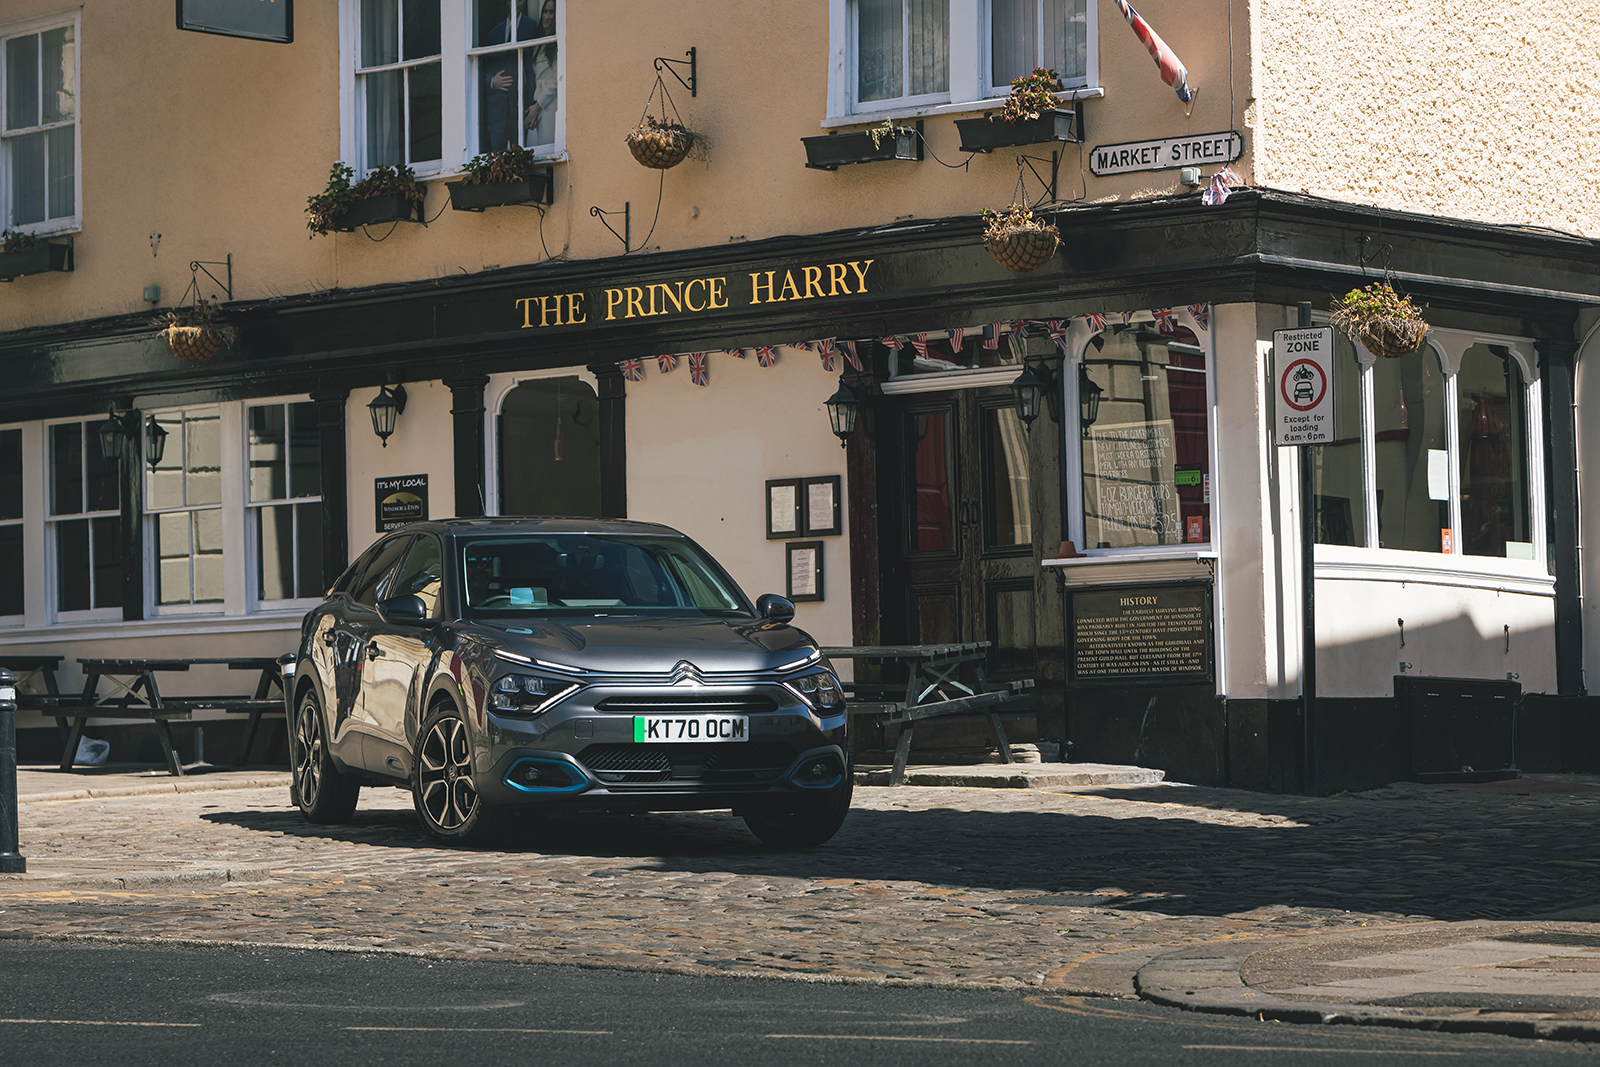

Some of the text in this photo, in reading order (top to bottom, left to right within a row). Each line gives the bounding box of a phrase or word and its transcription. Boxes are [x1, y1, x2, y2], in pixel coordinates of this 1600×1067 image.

[1098, 138, 1235, 169] MARKET STREET
[515, 259, 874, 329] THE PRINCE HARRY
[1284, 332, 1322, 341] Restricted
[1287, 341, 1319, 352] ZONE
[1284, 415, 1310, 423] Except
[1290, 424, 1319, 433] loading
[390, 480, 401, 490] MY
[402, 478, 426, 488] LOCAL
[1120, 596, 1158, 606] HISTORY
[648, 719, 744, 739] KT70 OCM
